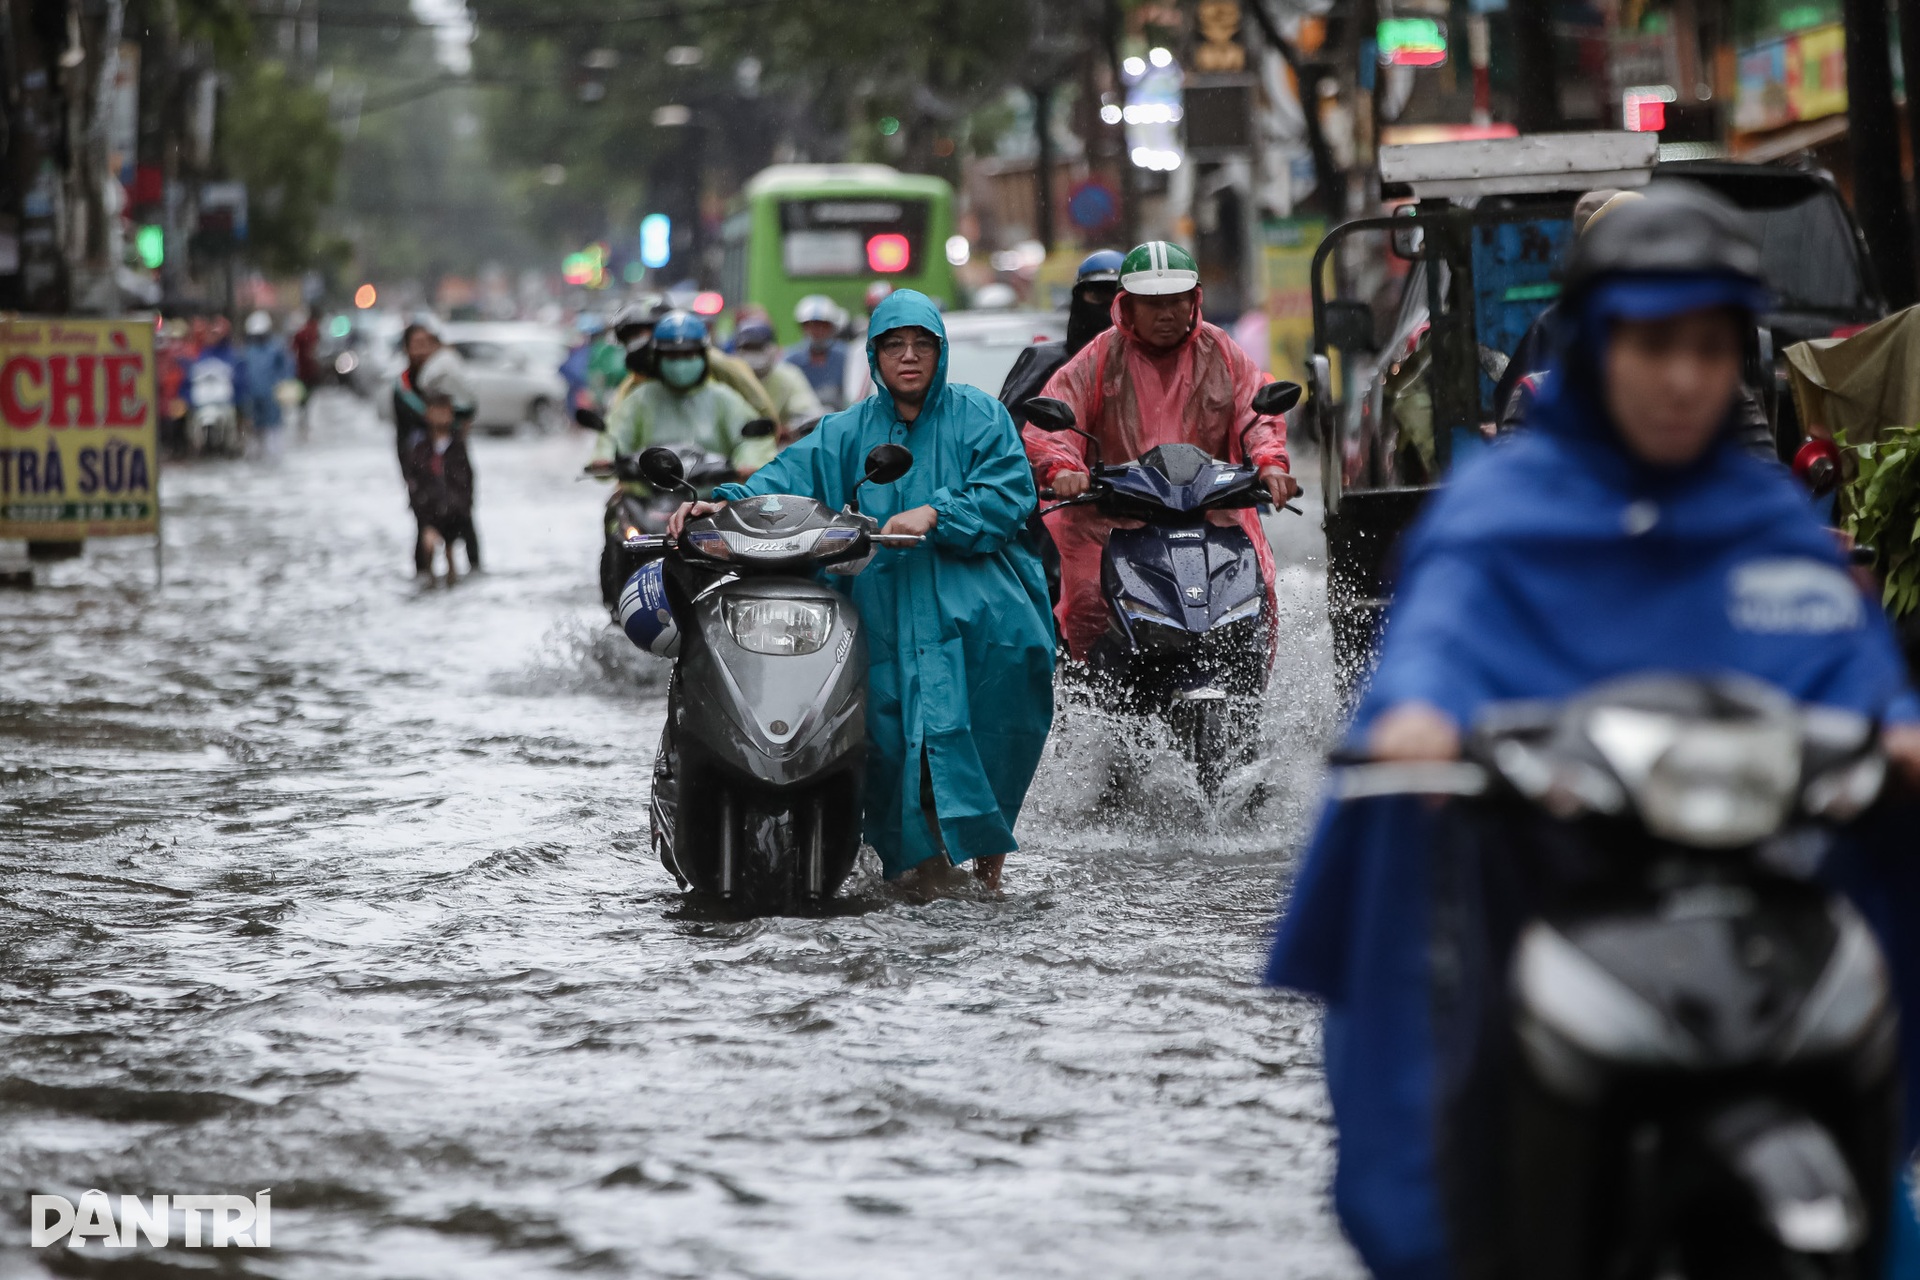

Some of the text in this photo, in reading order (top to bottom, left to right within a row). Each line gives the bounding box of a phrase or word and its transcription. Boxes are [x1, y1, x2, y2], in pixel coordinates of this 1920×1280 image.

[1, 330, 147, 429] CHÈ
[0, 436, 149, 494] TRÀ SỮA
